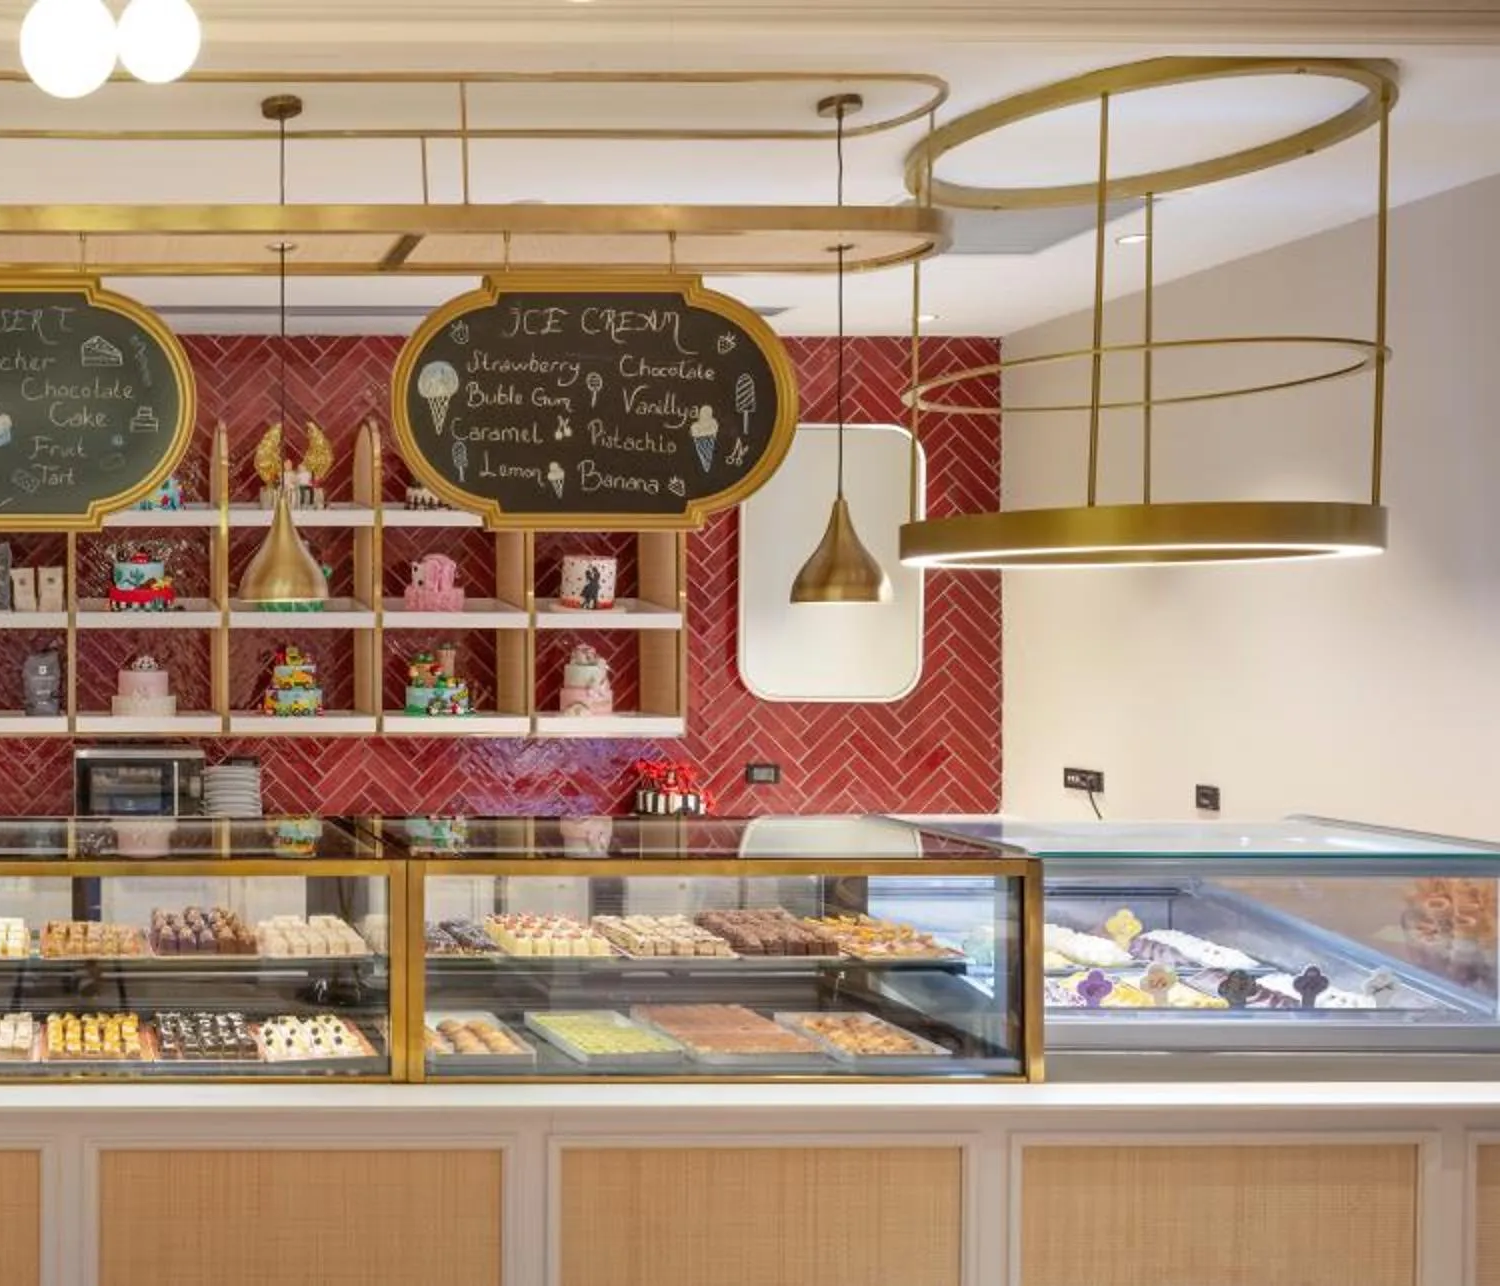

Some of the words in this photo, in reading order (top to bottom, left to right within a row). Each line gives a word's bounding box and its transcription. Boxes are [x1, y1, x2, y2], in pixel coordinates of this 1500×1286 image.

[502, 307, 570, 338] ICE
[581, 307, 699, 354] CREAM
[467, 350, 579, 387] Strawberry
[620, 354, 715, 380] Chocolate
[21, 376, 133, 401] Chocolate
[466, 381, 523, 408] Buble
[532, 387, 573, 413] Gum
[50, 401, 109, 427] Cake
[622, 384, 699, 429] Vanillya
[451, 418, 543, 443] Caramel
[588, 418, 677, 453] Pistachio
[29, 435, 88, 459] Fruit
[32, 464, 76, 485] Tart
[479, 450, 545, 486] Lemon
[577, 459, 659, 494] Banana
